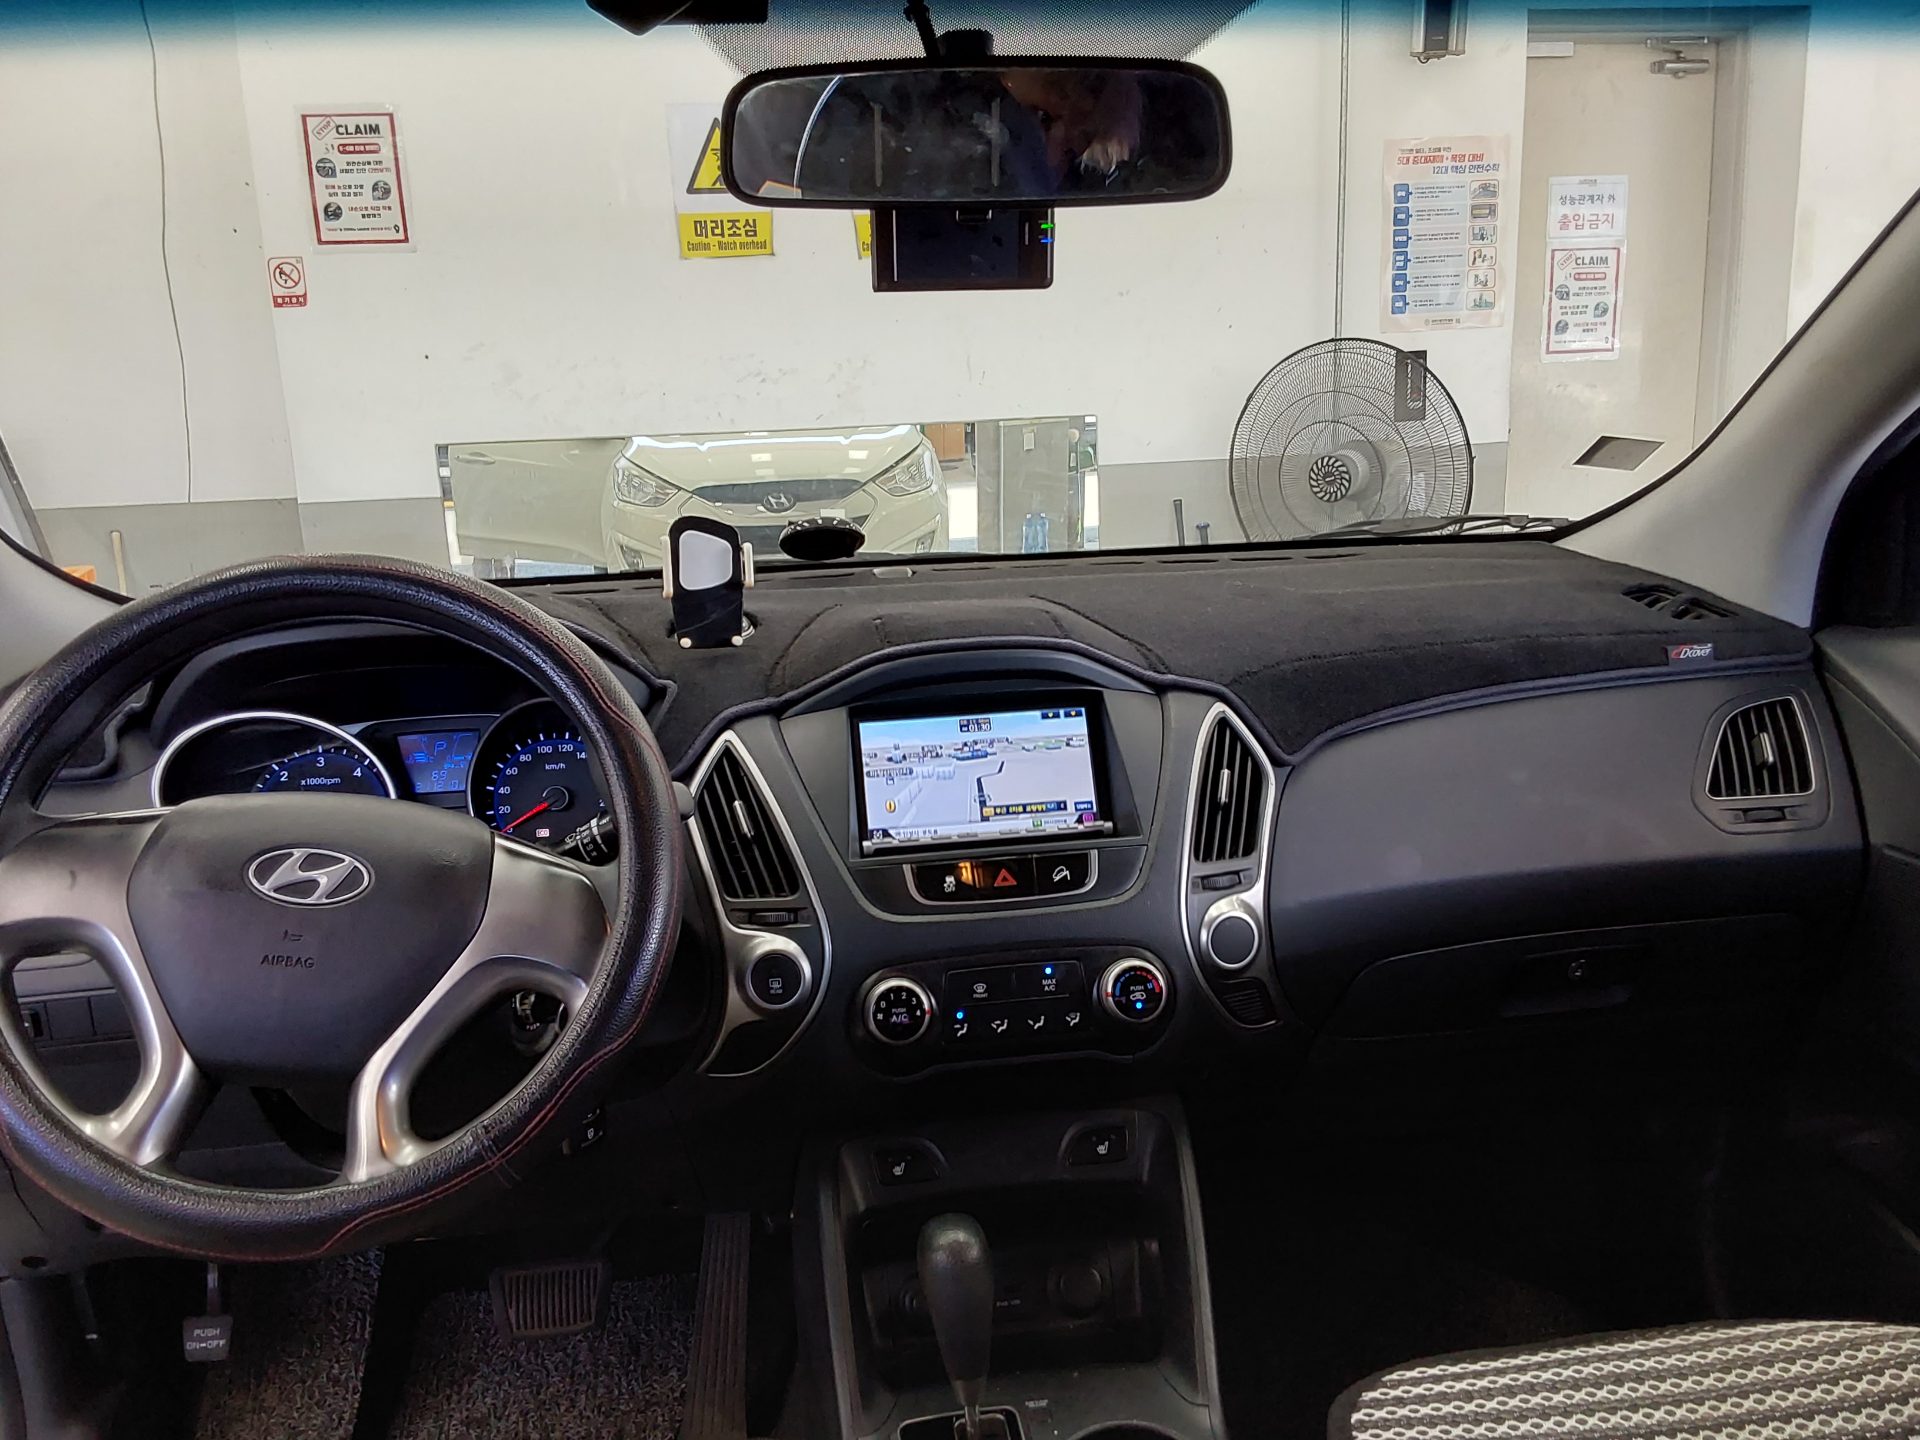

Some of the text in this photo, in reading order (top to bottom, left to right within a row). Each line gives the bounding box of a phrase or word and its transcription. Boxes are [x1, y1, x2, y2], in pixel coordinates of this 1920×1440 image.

[316, 120, 332, 136] STOP
[336, 124, 380, 135] CLAIM
[1559, 194, 1604, 206] 성능관계자
[1558, 212, 1614, 231] 출입금지
[693, 218, 758, 238] 머리조심
[687, 241, 711, 252] Caution
[718, 240, 737, 251] Watch
[739, 239, 767, 250] overhead
[1560, 253, 1573, 266] STOP
[1575, 256, 1609, 266] CLAIM
[434, 741, 447, 756] P
[558, 744, 574, 752] 120
[316, 757, 325, 767] 3
[280, 771, 289, 781] 2
[353, 767, 362, 777] 4
[505, 767, 518, 775] 60
[498, 786, 511, 794] 40
[498, 805, 511, 813] 20
[260, 954, 315, 969] AIRBAG
[891, 1014, 908, 1022] A/C
[193, 1328, 220, 1337] PUSH
